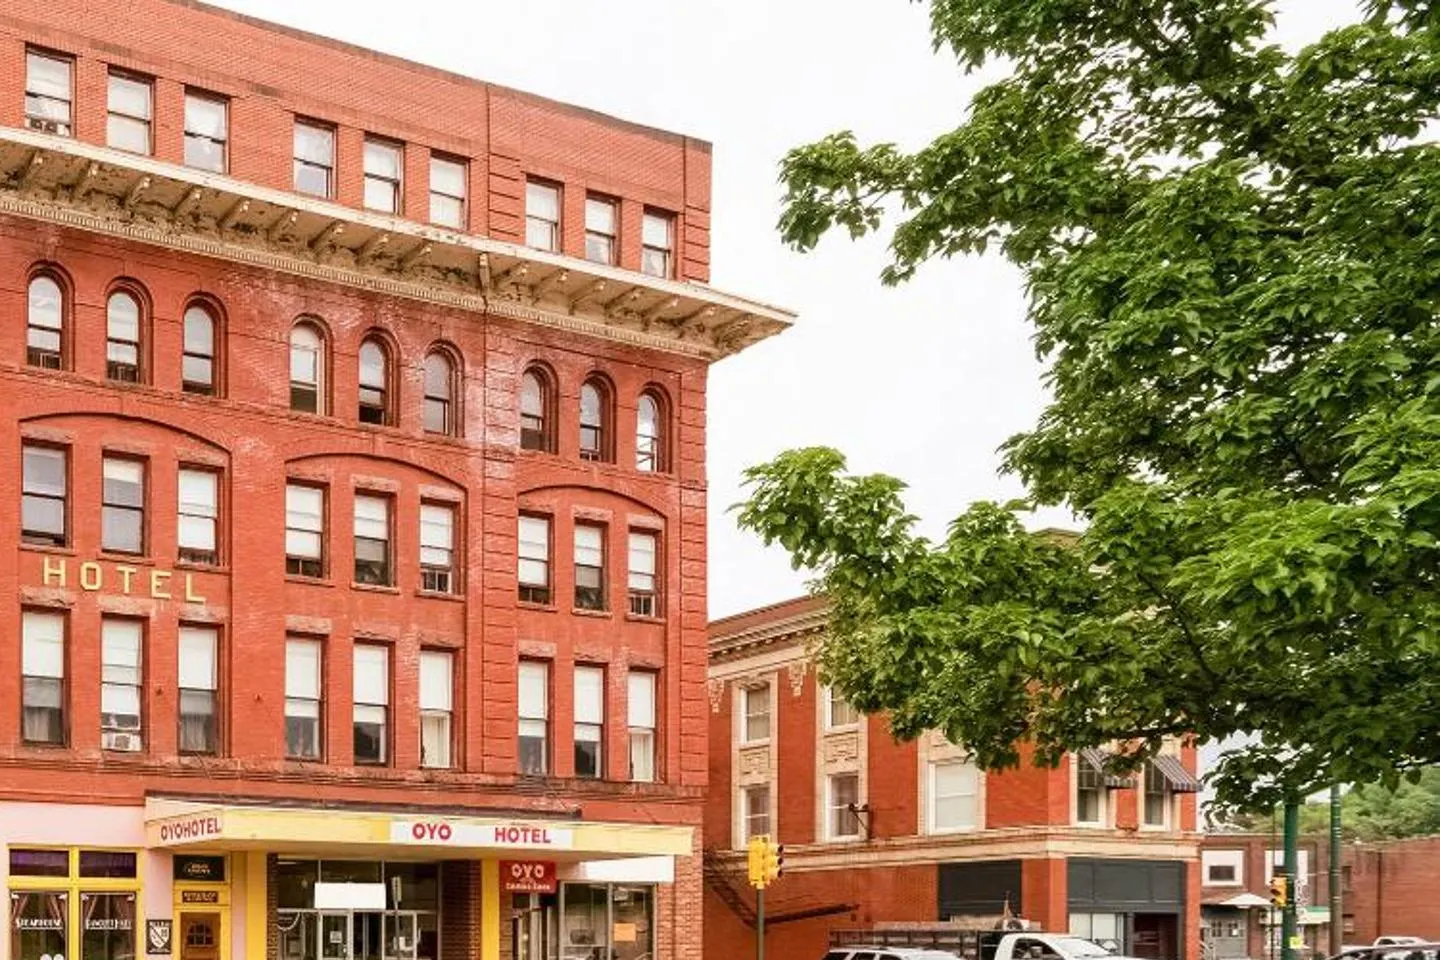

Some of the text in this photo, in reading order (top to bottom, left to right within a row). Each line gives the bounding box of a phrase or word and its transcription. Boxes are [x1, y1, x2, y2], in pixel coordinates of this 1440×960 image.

[42, 555, 207, 604] HOTEL
[412, 823, 552, 844] OYO HOTEL
[511, 863, 545, 879] OYO
